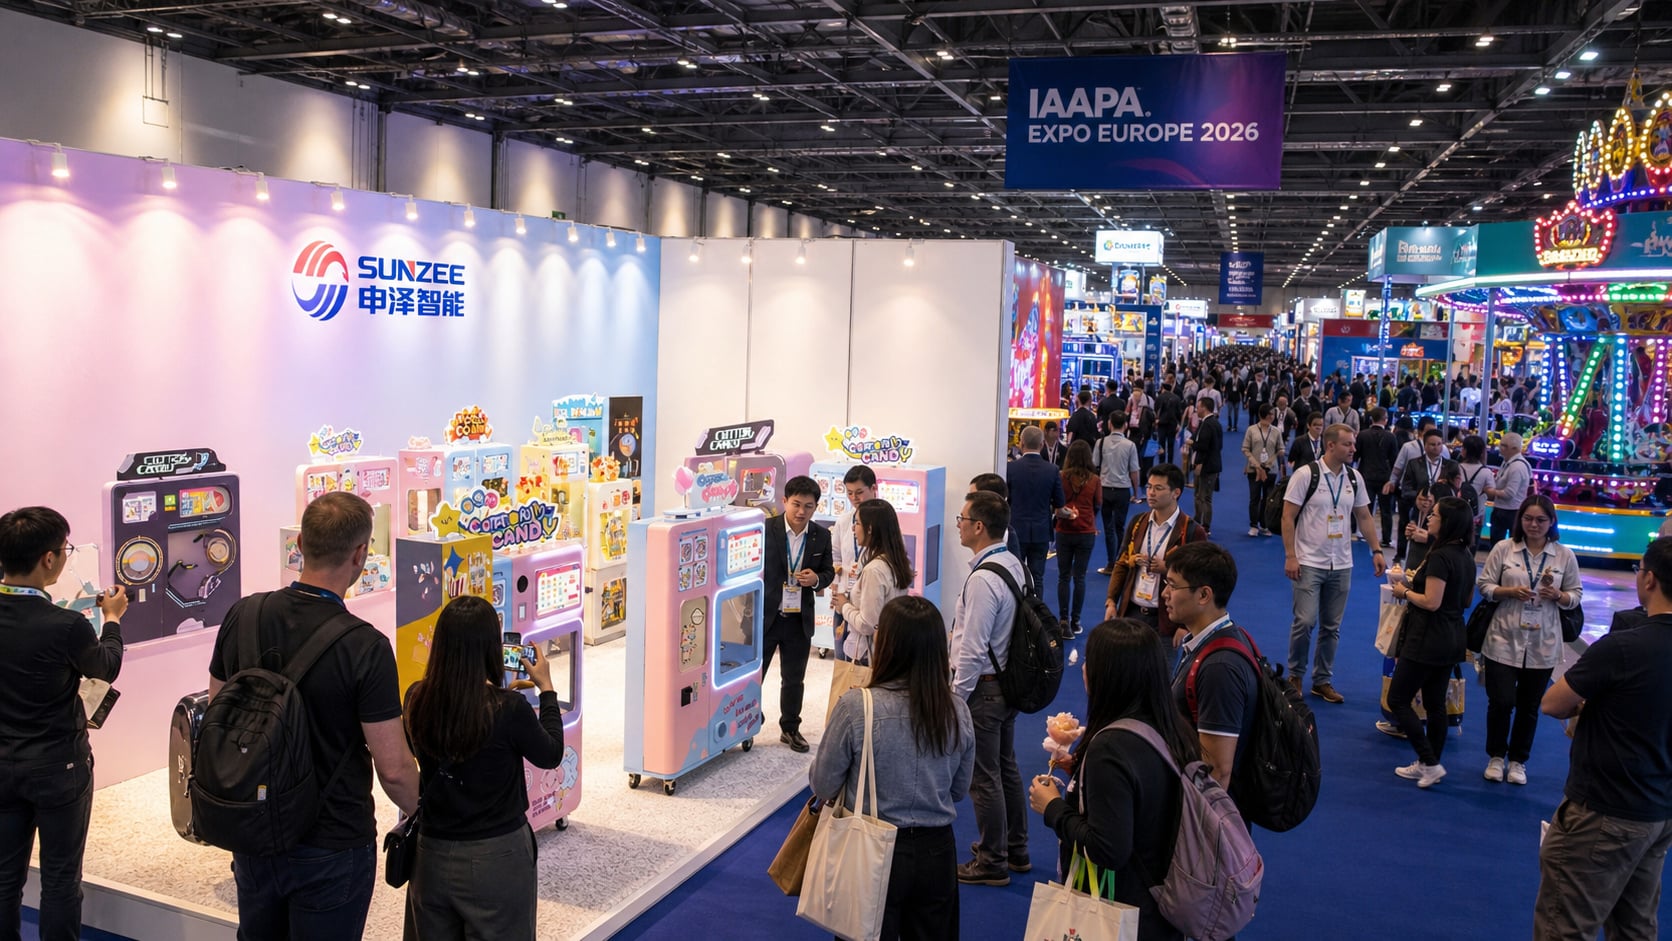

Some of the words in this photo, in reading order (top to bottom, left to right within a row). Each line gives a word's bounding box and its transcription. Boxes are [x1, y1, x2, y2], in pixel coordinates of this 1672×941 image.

[1028, 124, 1091, 143] EXPO
[1098, 122, 1194, 143] EUROPE
[1200, 122, 1259, 142] 2026
[358, 256, 465, 285] SUNZEE
[358, 285, 465, 317] 申泽智能
[861, 447, 913, 465] CANDY
[492, 516, 559, 550] CANDY
